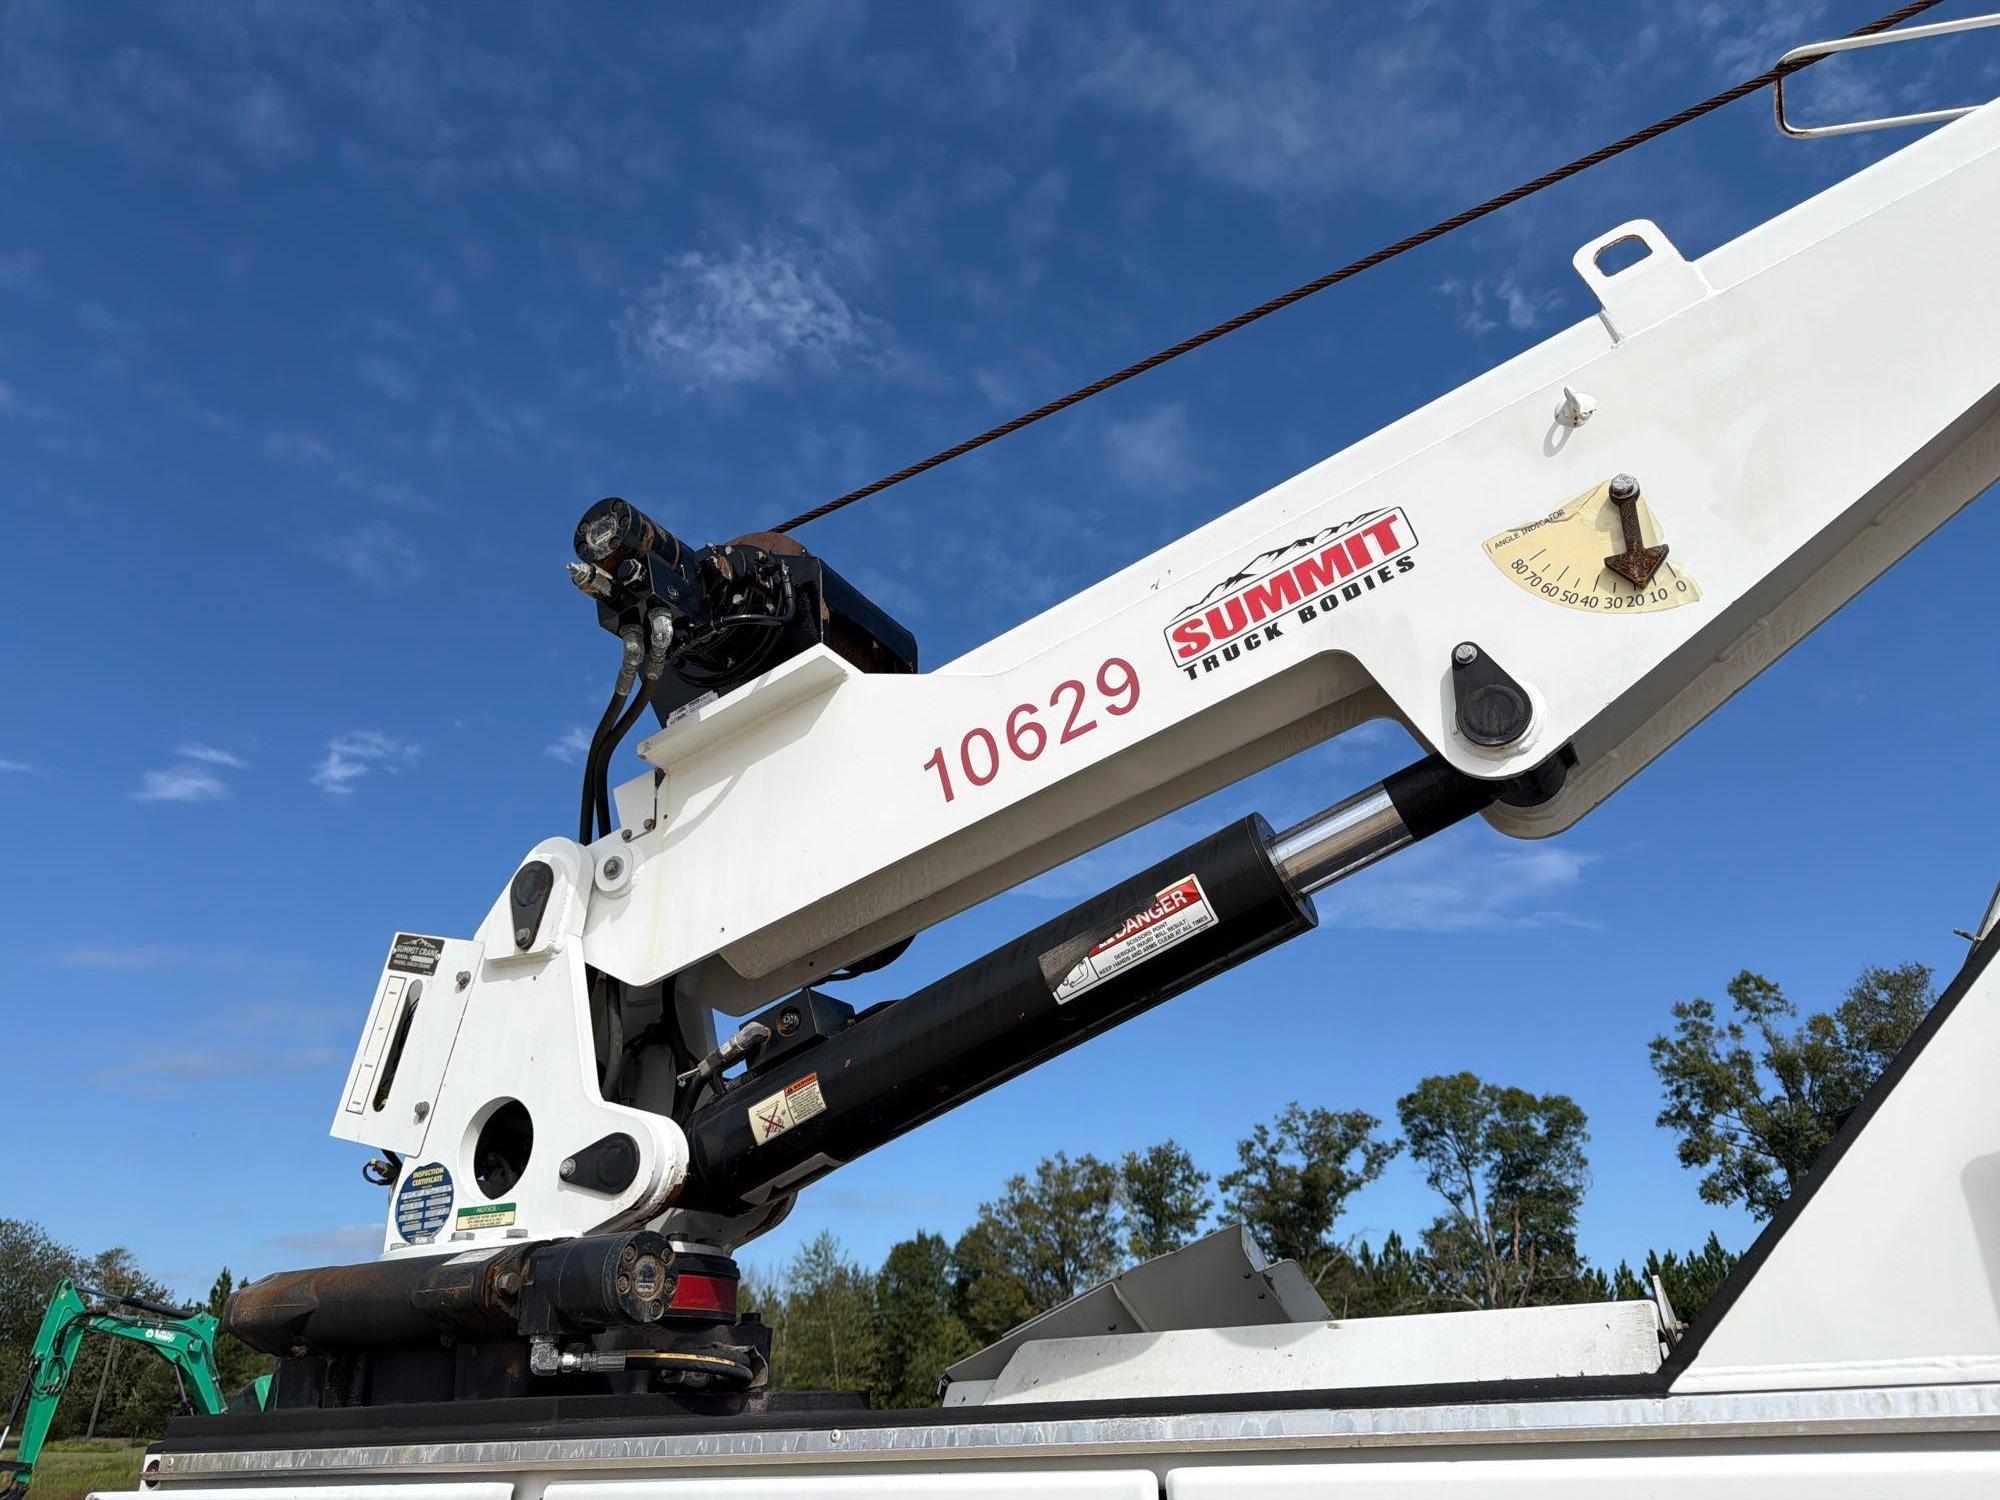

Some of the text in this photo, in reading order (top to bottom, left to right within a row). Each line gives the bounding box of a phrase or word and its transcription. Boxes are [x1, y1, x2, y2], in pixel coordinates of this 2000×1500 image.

[1494, 509, 1566, 549] ANGLE INDICATOR
[1172, 514, 1401, 659] SUMMIT
[1510, 558, 1687, 609] 80 70 60 50 40 30 20 10 0
[1183, 555, 1415, 681] TRUCK BODIES
[923, 657, 1140, 803] 10629
[1098, 965, 1112, 975] KEEP
[1112, 956, 1131, 968] HANDS
[1131, 950, 1143, 959] AND
[1143, 942, 1158, 953] ARMS
[1158, 932, 1175, 944] CLEAR
[1183, 925, 1191, 933] ALL
[1192, 915, 1209, 927] TIMES
[1114, 919, 1187, 960] SERIOUS INJURY WILL RESULT
[1126, 921, 1169, 947] SCISSORS POINT
